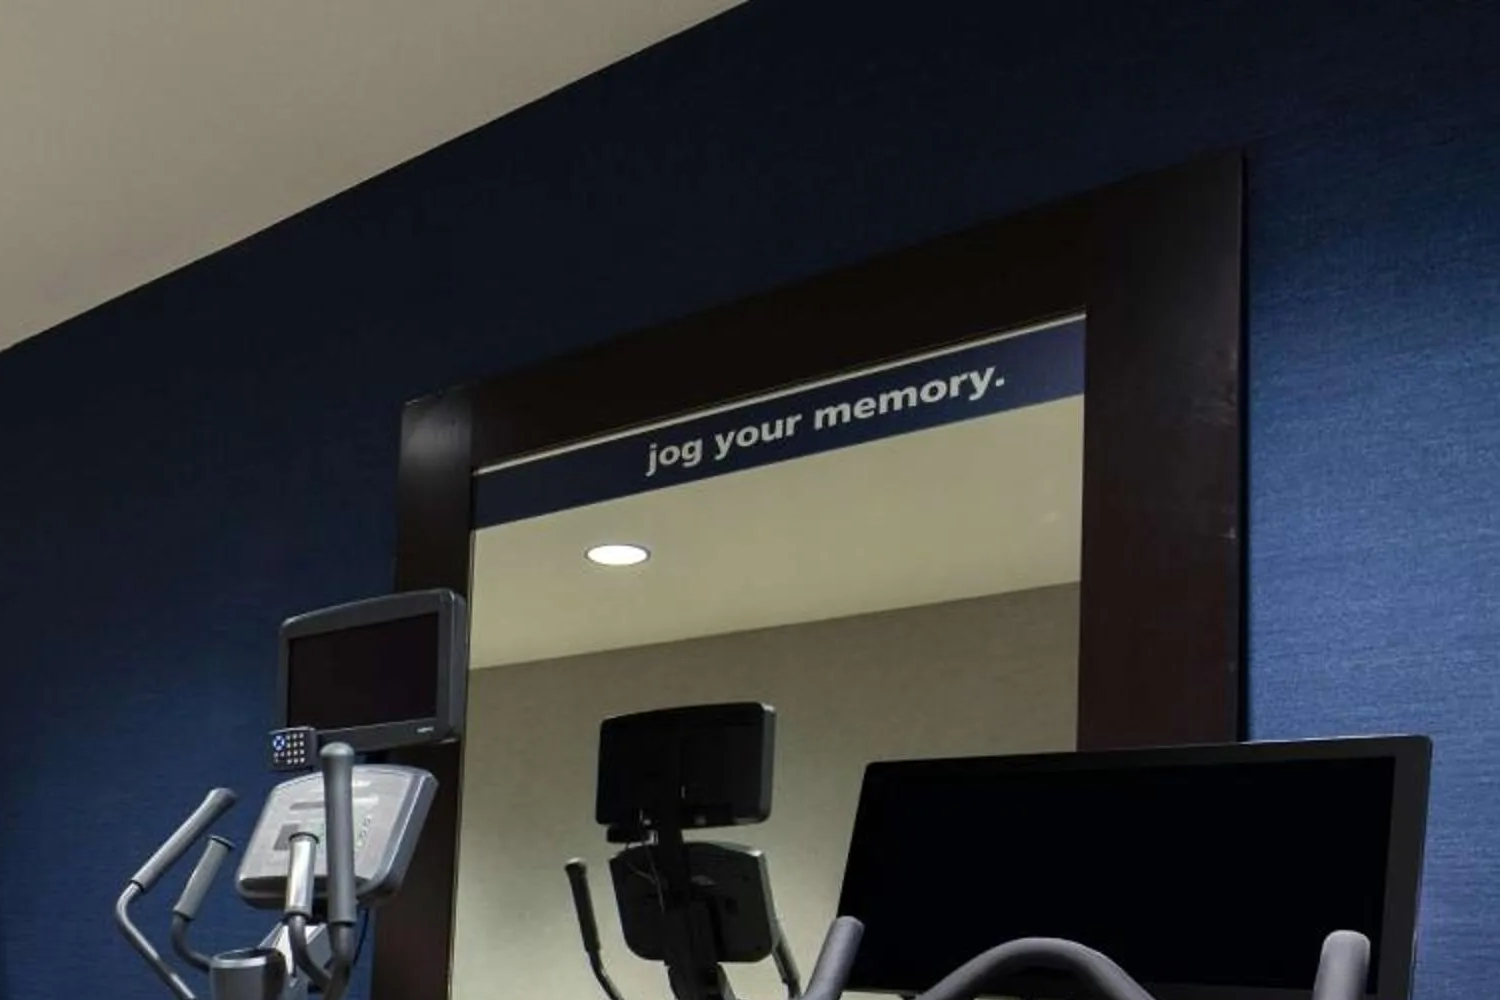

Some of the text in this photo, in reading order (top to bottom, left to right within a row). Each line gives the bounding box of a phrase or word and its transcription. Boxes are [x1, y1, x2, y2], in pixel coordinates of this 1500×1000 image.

[645, 366, 1005, 477] jog your memory.
